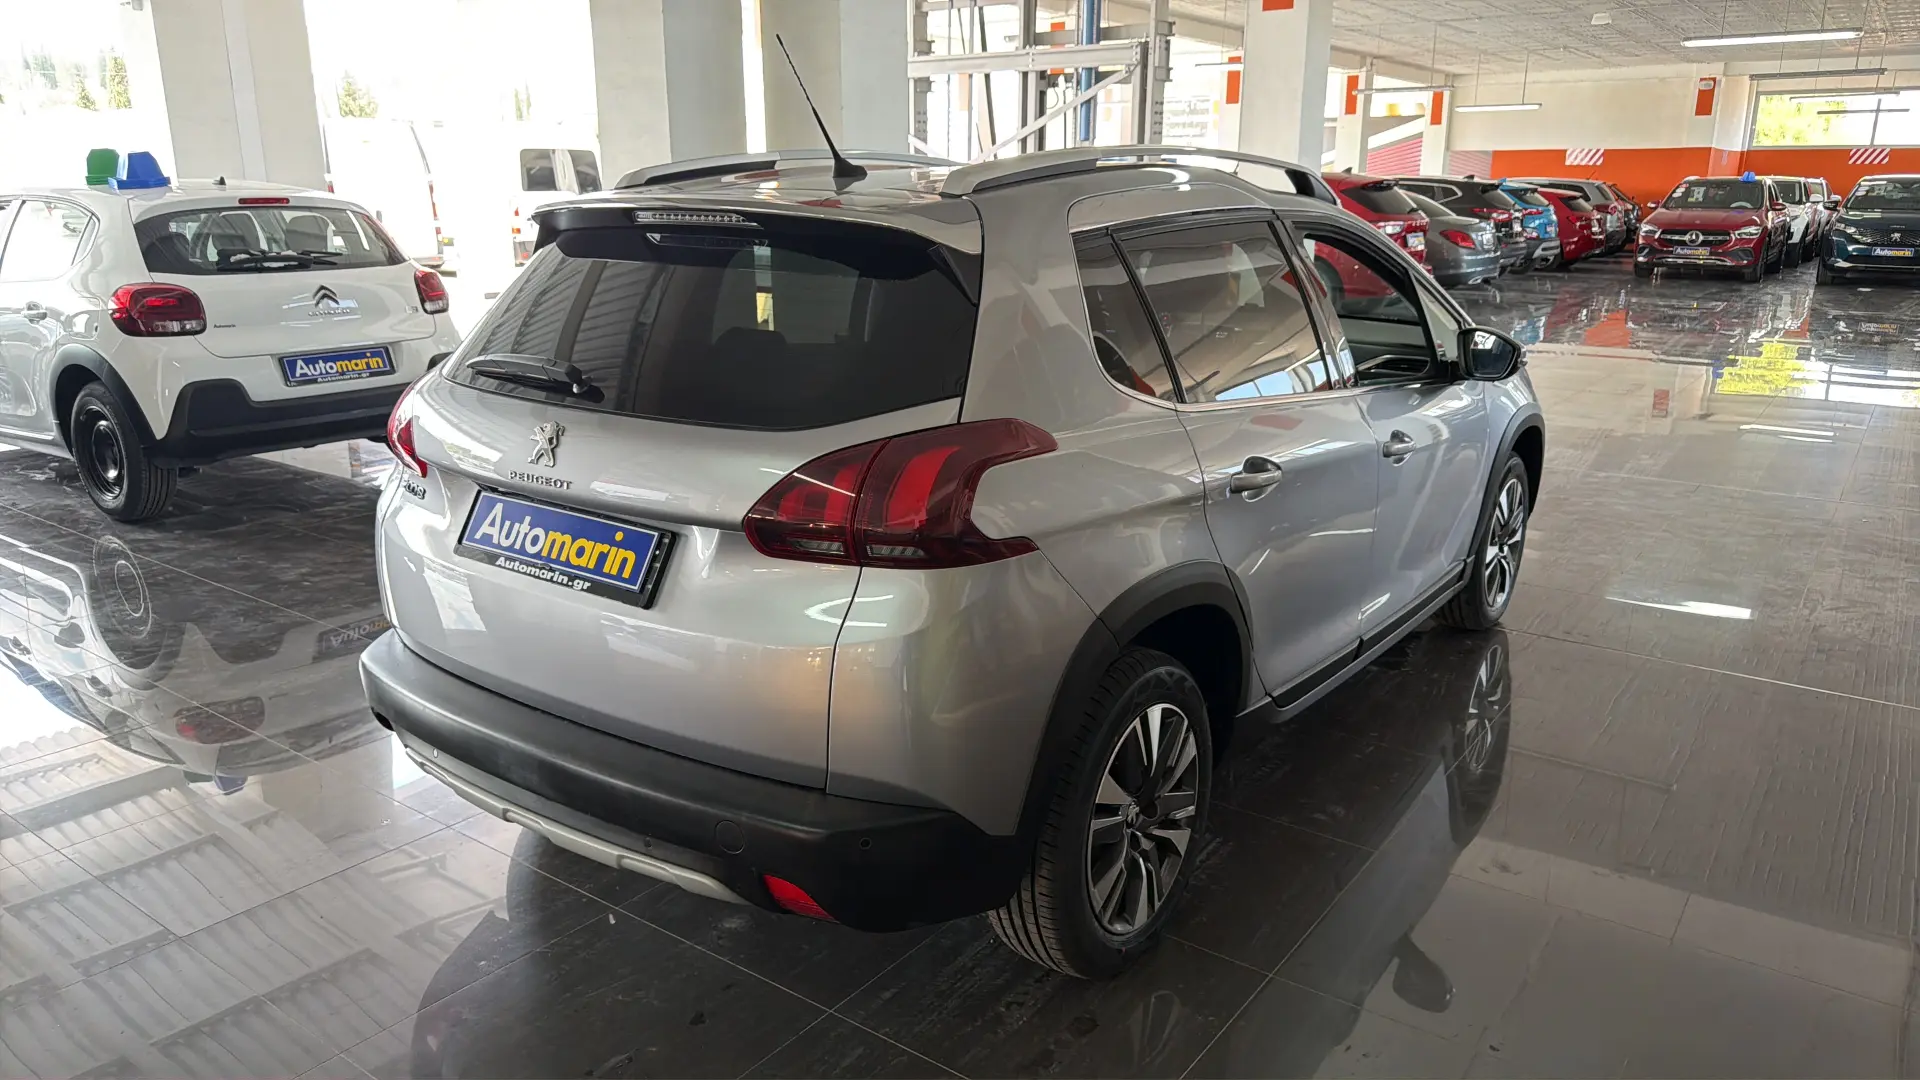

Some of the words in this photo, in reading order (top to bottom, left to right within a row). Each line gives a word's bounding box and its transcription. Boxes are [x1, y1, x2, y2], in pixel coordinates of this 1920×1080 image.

[295, 352, 384, 378] Automarin
[509, 469, 573, 490] PEUGEOT
[474, 502, 636, 579] Automarin
[495, 556, 592, 591] Automarin.gr
